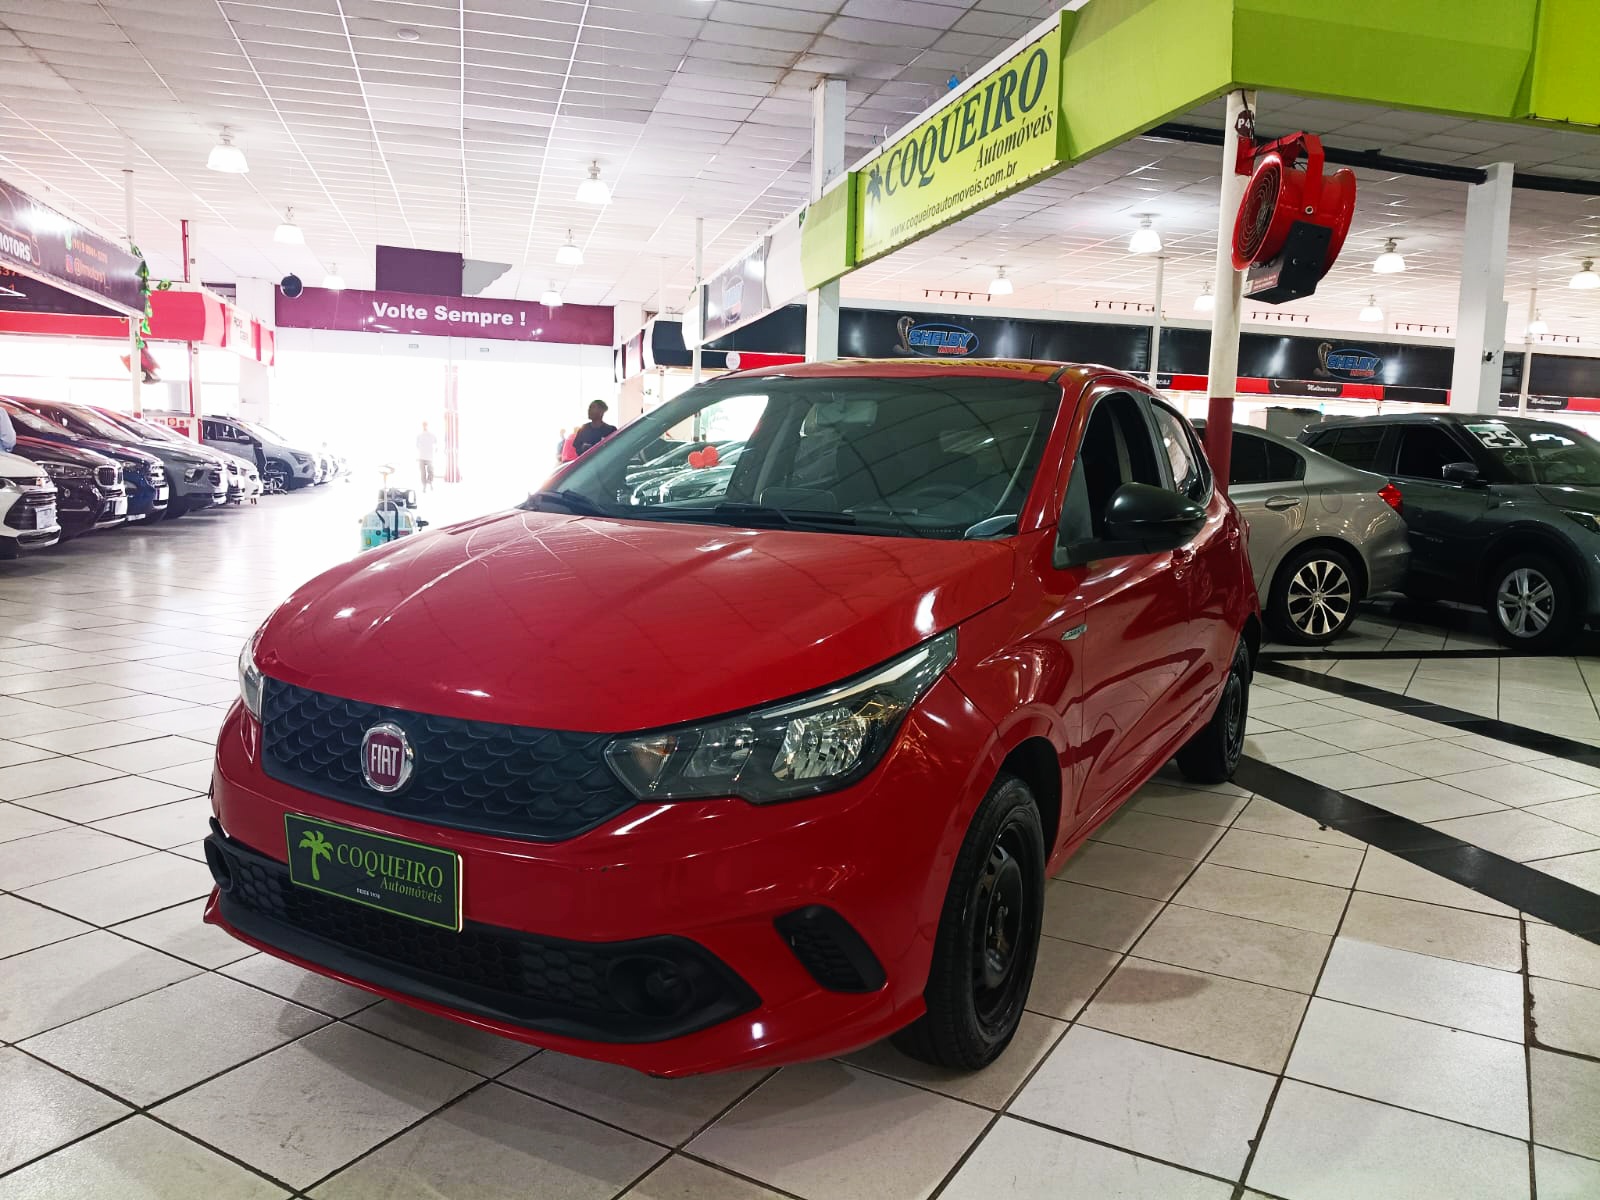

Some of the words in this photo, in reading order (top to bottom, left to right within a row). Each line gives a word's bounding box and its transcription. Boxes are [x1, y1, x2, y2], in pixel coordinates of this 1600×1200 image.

[885, 48, 1049, 188] COQUEIRO
[973, 104, 1054, 172] Automóveis
[889, 160, 1018, 238] www.coqueiroautomoveis.com.br
[373, 302, 428, 320] Volte
[434, 305, 514, 328] Sempre
[908, 329, 975, 349] SHELBY
[1327, 354, 1381, 370] SHELBY
[1478, 430, 1522, 447] 25
[370, 743, 400, 777] FIAT
[337, 843, 443, 889] COQUEIRO
[380, 876, 443, 904] Automóveis
